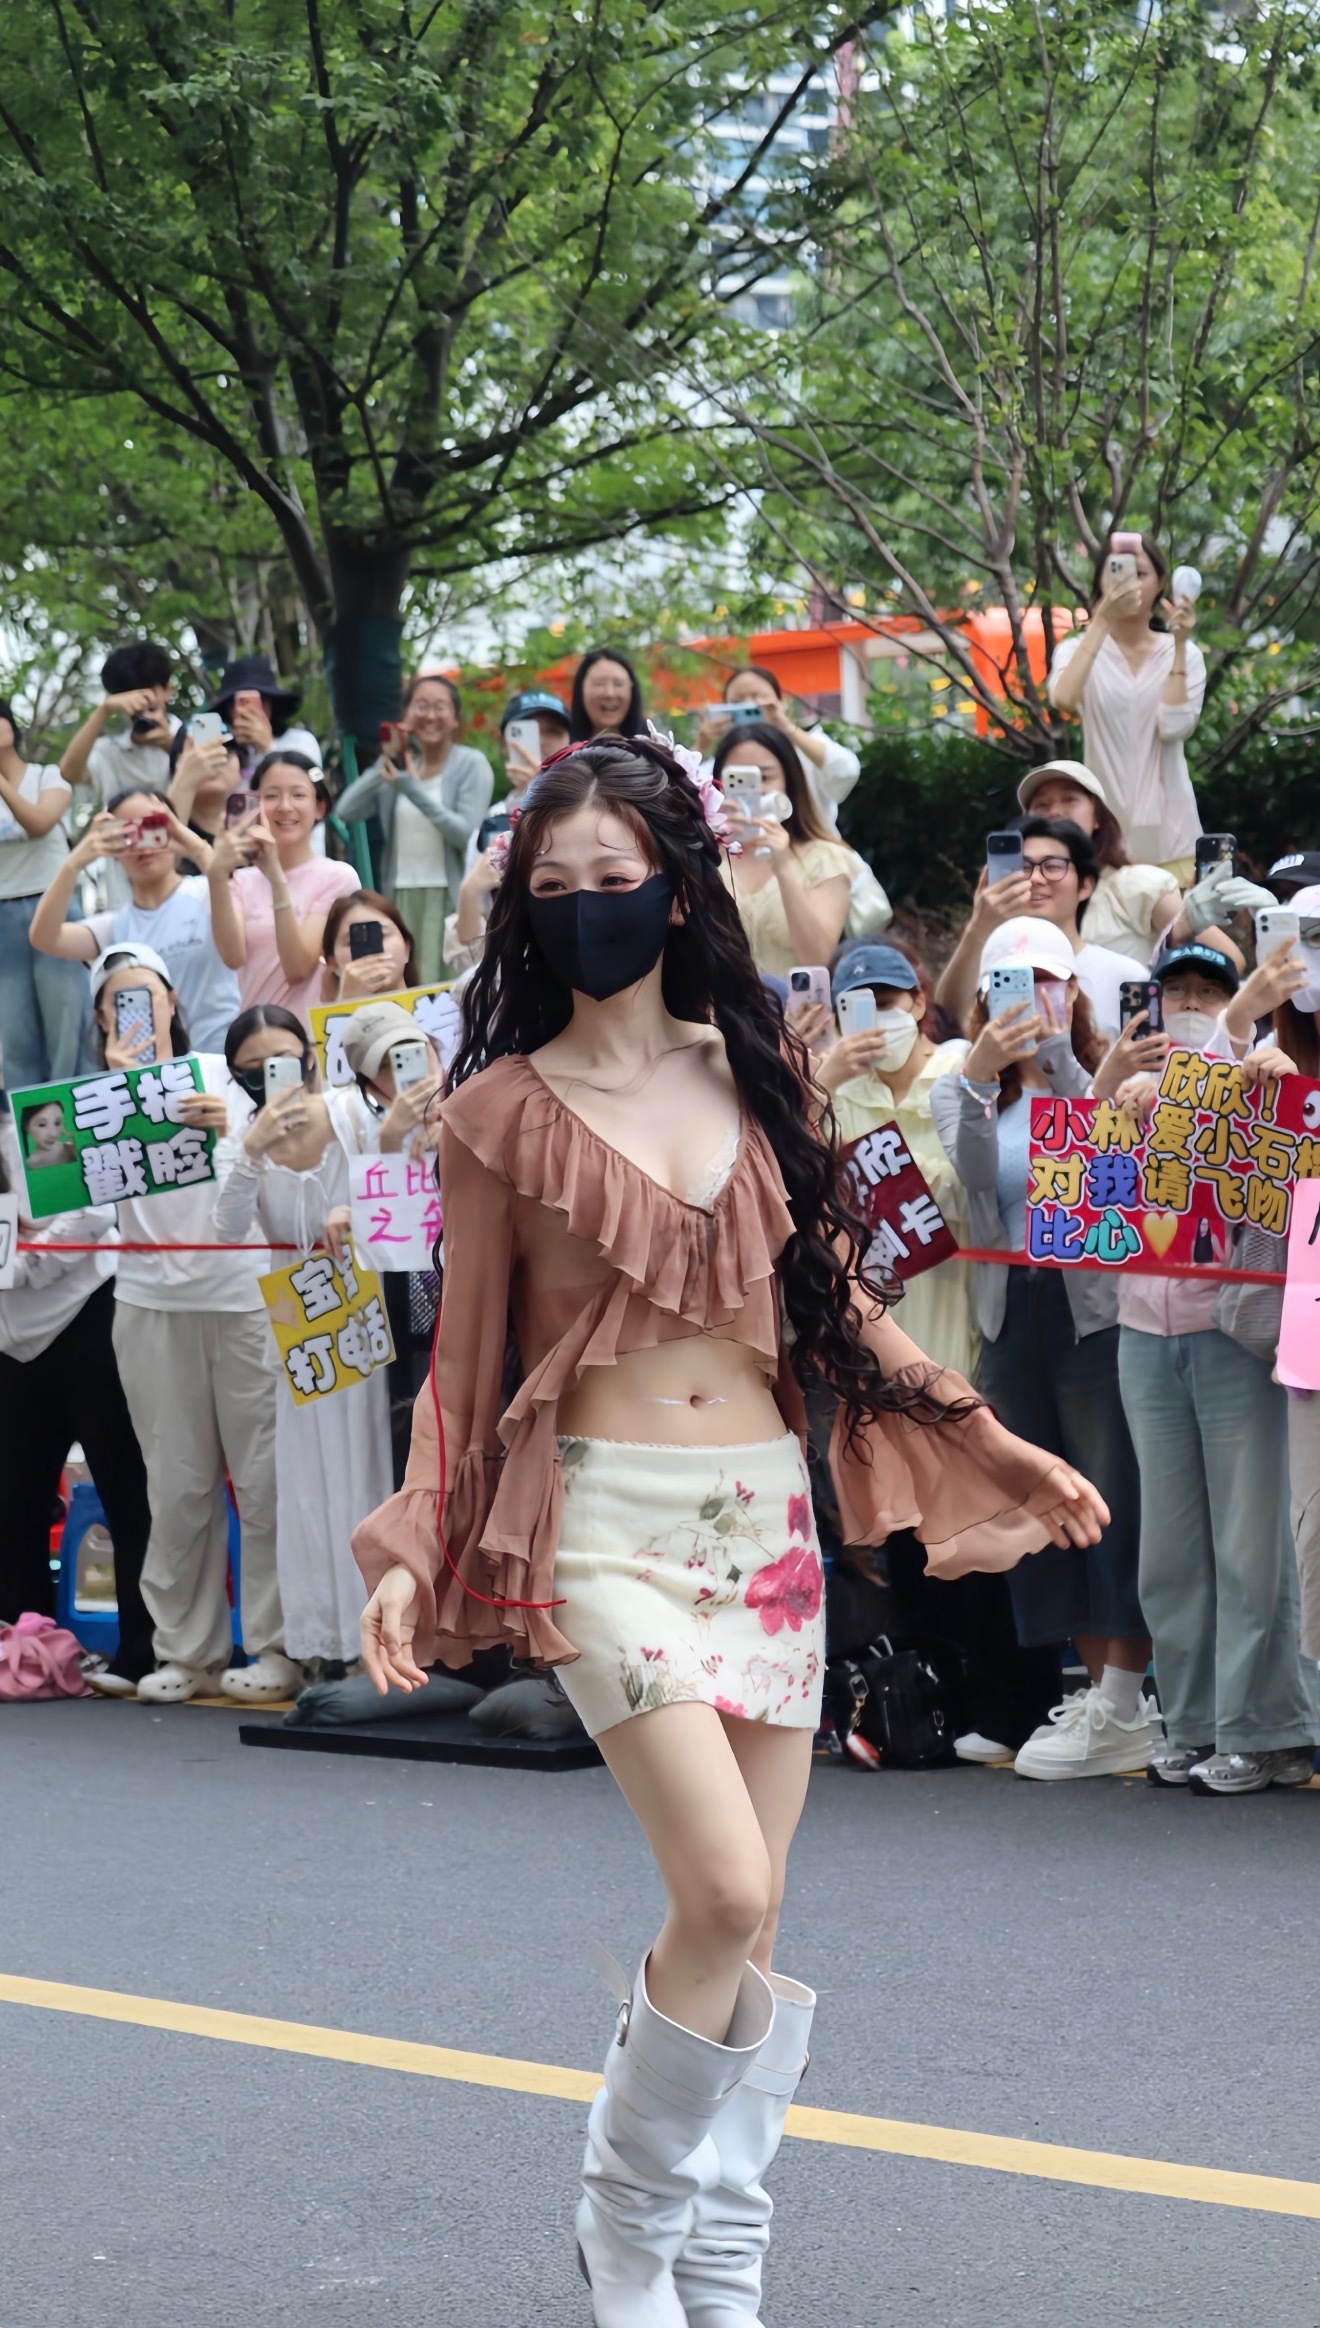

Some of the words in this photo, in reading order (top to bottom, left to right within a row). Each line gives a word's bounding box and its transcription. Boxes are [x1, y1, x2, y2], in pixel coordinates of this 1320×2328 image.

[72, 1062, 199, 1141] 手指
[1031, 1098, 1144, 1154] 小林
[1028, 1152, 1139, 1207] 对我
[1143, 1153, 1290, 1236] 请飞吻
[1030, 1207, 1141, 1262] 比心
